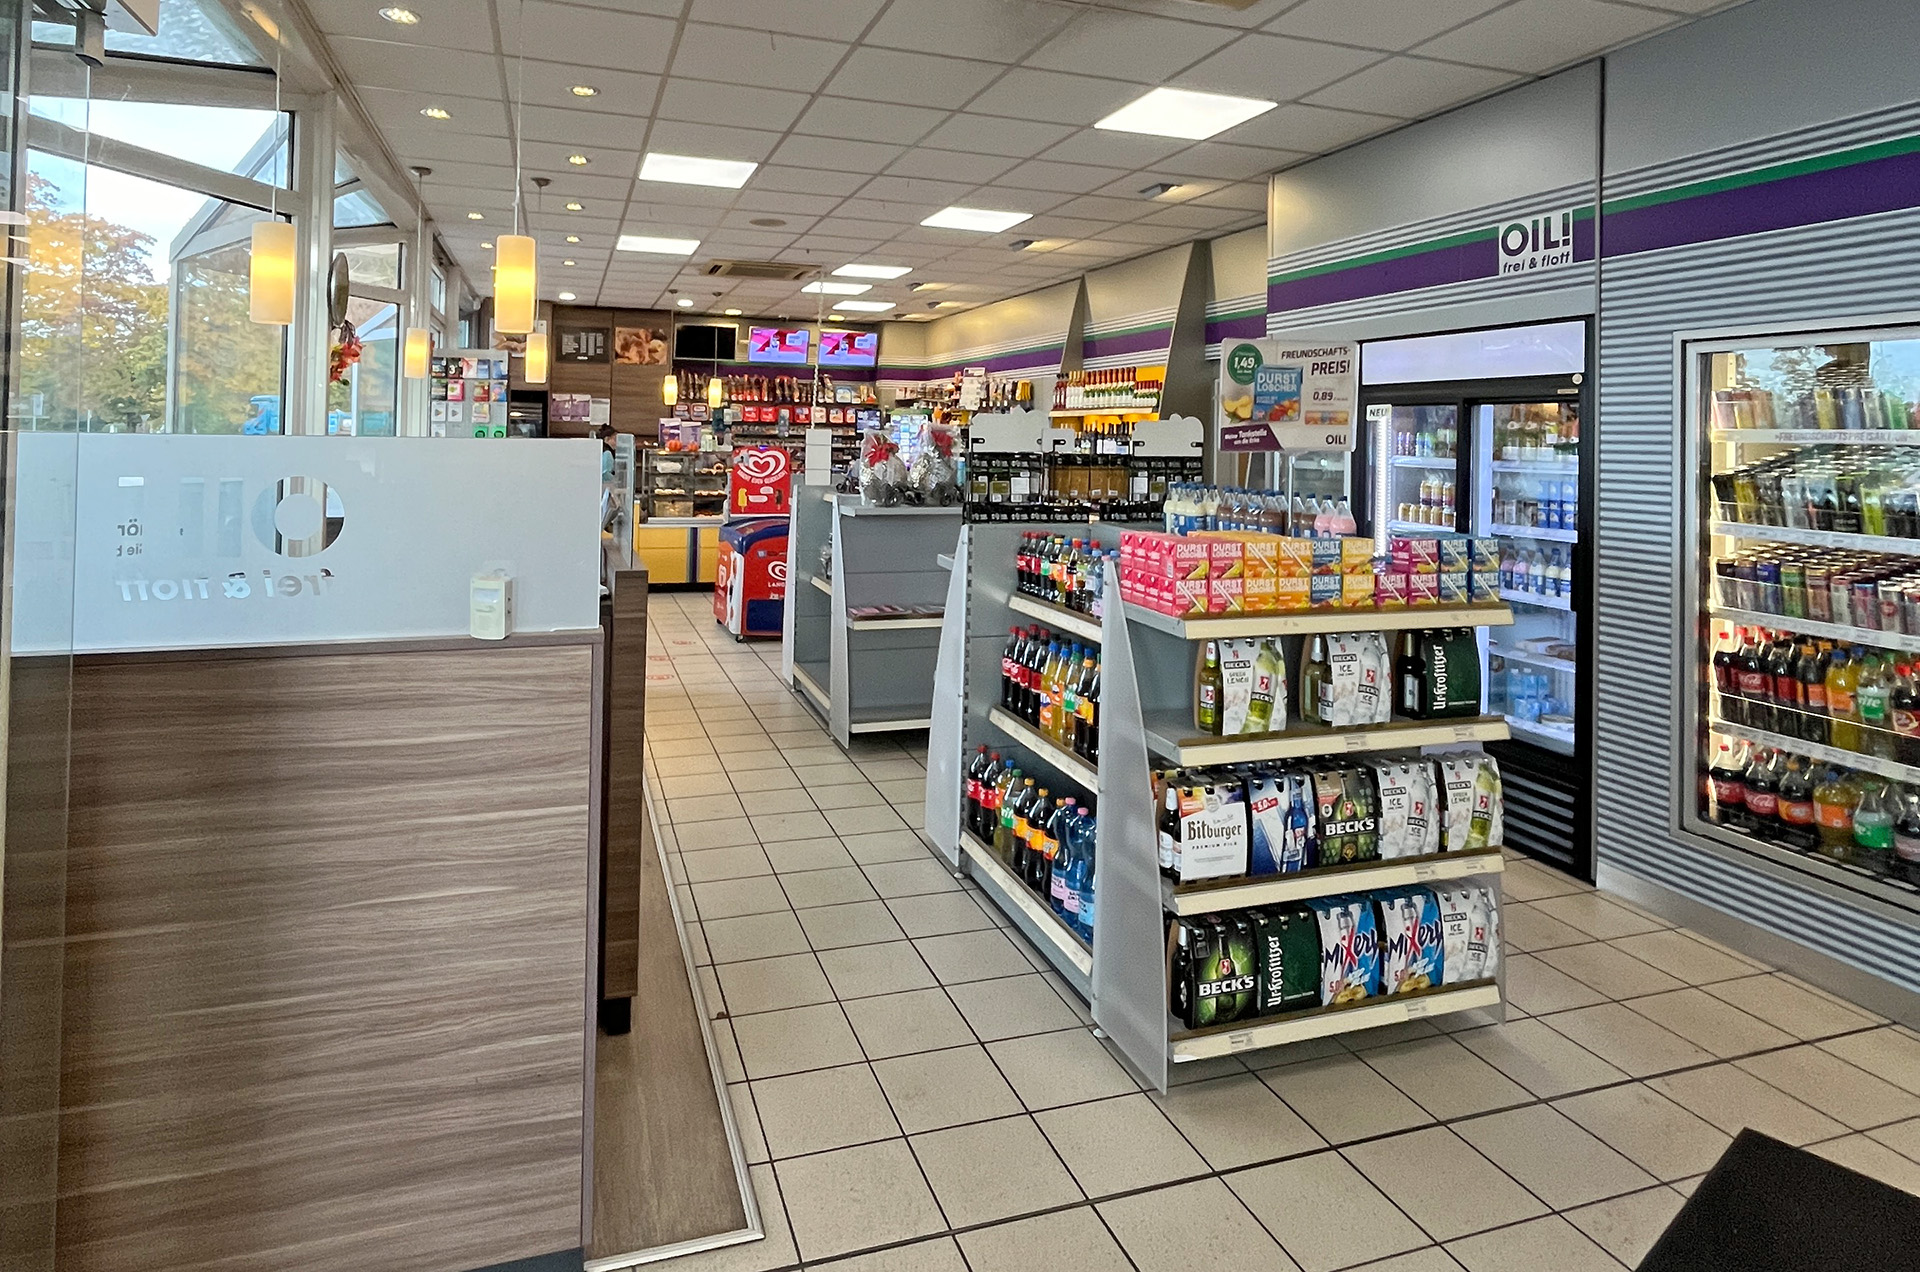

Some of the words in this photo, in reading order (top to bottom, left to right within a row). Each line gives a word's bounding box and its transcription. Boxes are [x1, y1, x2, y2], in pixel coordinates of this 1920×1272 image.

[1501, 212, 1570, 257] OIL!
[1503, 260, 1525, 274] frei
[1529, 257, 1537, 270] &
[1541, 251, 1571, 268] flott
[1281, 346, 1351, 360] FREUNDSCHAFTS-
[1311, 359, 1351, 376] PREIS!
[1257, 372, 1297, 384] DURST
[1325, 434, 1347, 445] OIL!
[1176, 543, 1208, 552] DURST
[1212, 543, 1242, 552] DURST
[1312, 541, 1340, 549] DURST
[1312, 576, 1340, 584] DURST
[1340, 664, 1352, 673] ICE
[1389, 798, 1402, 807] ICE
[1187, 820, 1242, 841] Bitburger
[1325, 817, 1375, 837] BECK'S
[1450, 924, 1463, 932] ICE
[1199, 975, 1254, 997] BECK'S
